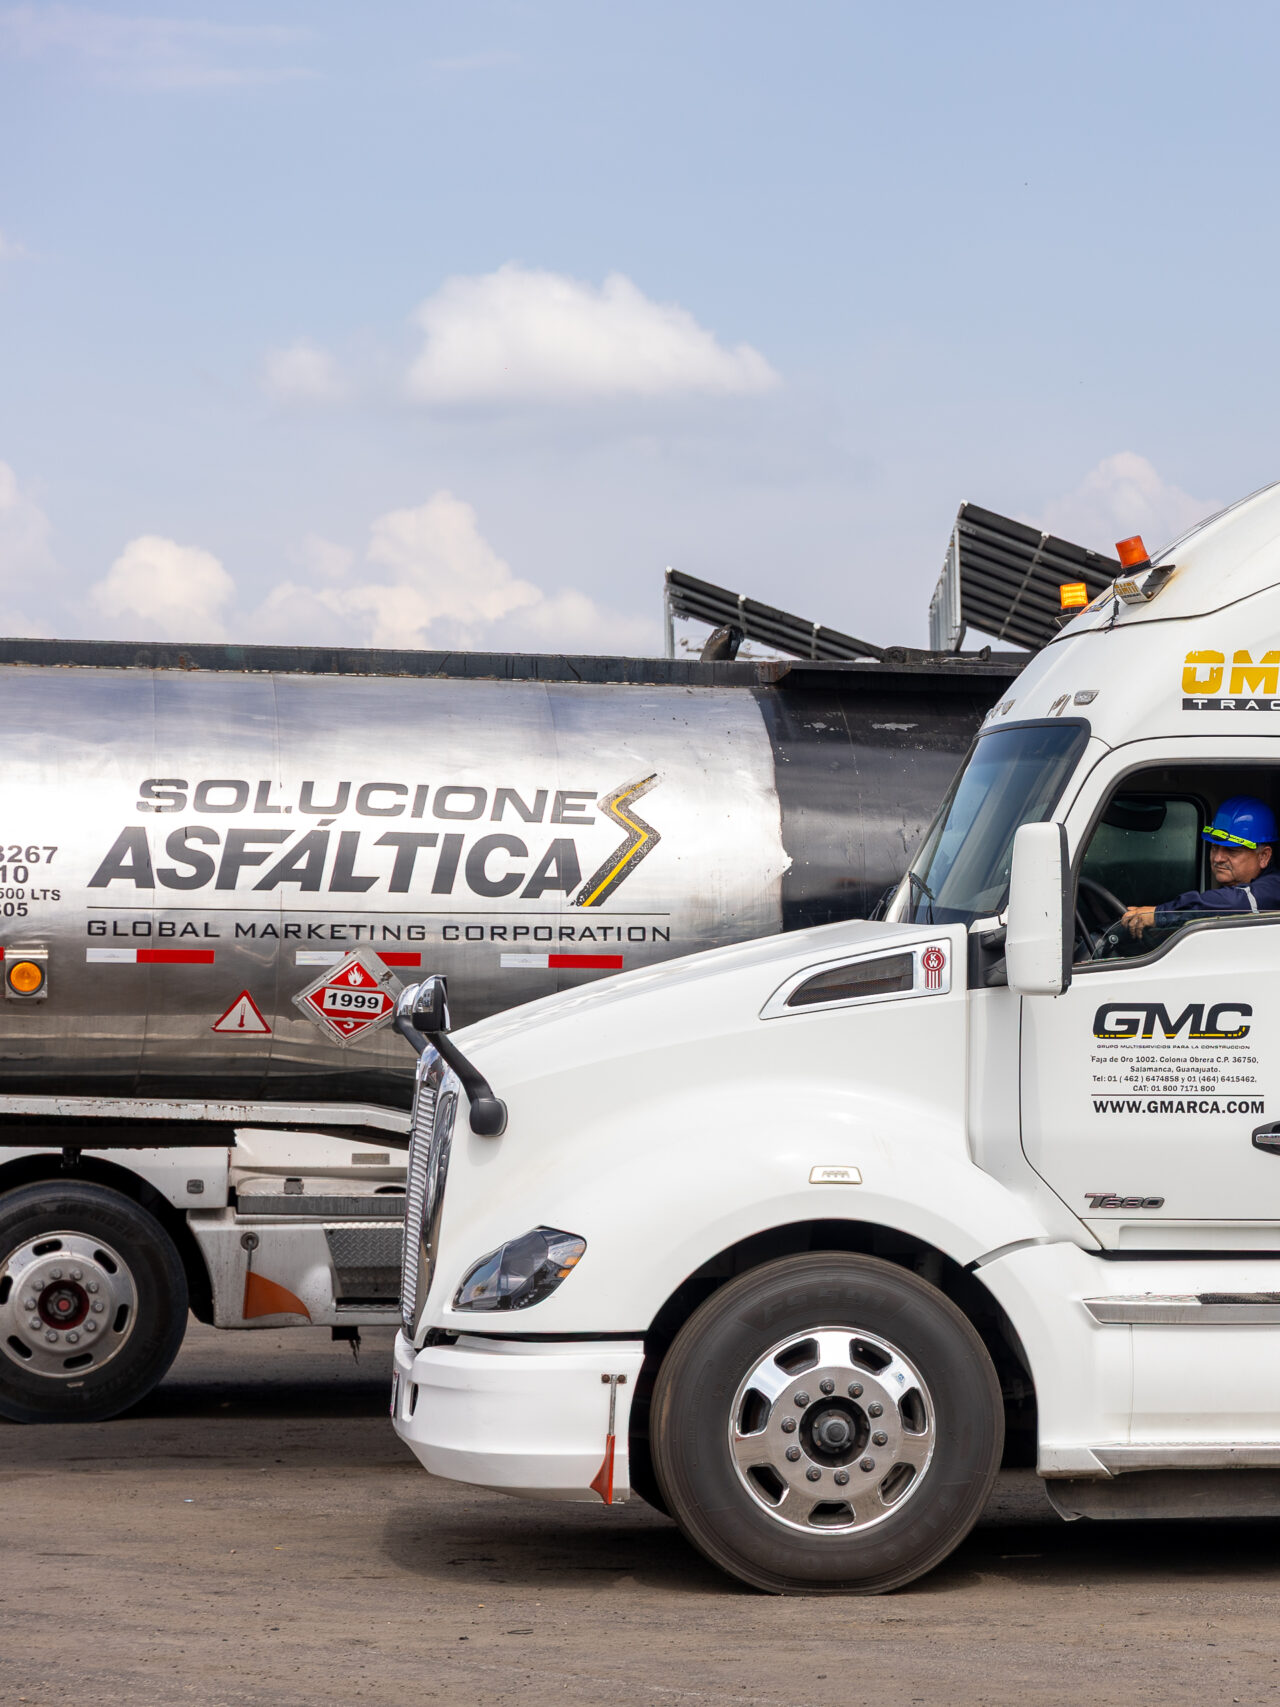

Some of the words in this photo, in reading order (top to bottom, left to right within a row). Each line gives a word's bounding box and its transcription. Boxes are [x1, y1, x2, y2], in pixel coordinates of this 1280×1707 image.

[31, 888, 61, 901] LTS
[0, 902, 28, 917] 05
[87, 920, 220, 938] GLOBAL
[235, 922, 426, 940] MARKETING
[442, 925, 670, 942] CORPORATION
[328, 992, 379, 1009] 1999
[1093, 1003, 1253, 1039] GMC
[1091, 1056, 1107, 1064] Faja
[1199, 1075, 1219, 1083] (464)
[1093, 1100, 1264, 1114] WWW.GMARCA.COM
[1084, 1193, 1165, 1208] T680
